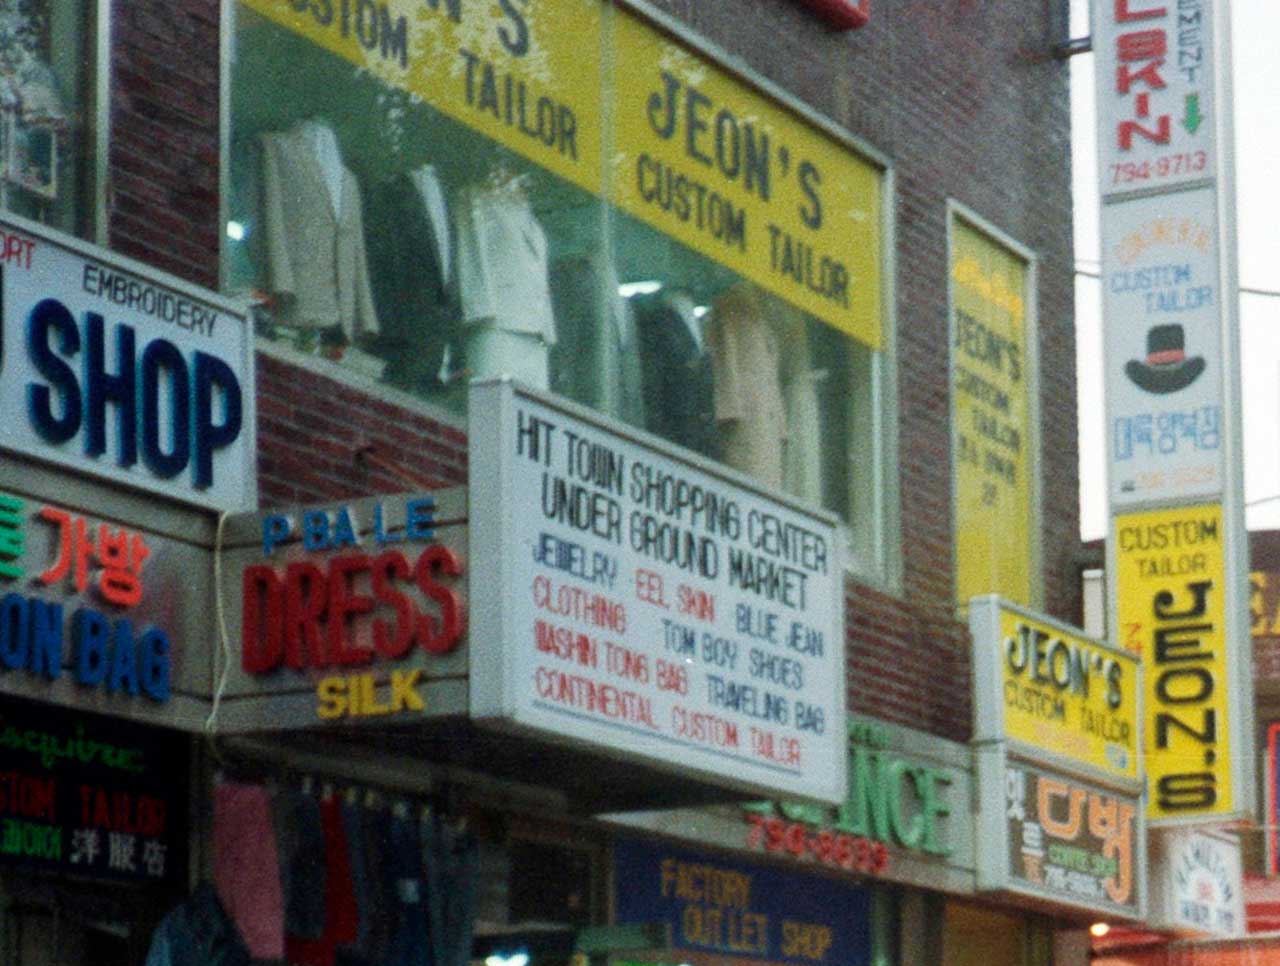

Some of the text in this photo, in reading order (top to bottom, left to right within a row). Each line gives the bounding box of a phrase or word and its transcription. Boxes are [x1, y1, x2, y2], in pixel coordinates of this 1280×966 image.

[460, 47, 578, 162] TAILOR
[647, 70, 822, 231] JEON'S
[637, 153, 747, 253] CUSTOM
[767, 222, 850, 309] TAILOR
[82, 263, 218, 337] EMBROIDERY
[25, 298, 243, 492] SHOP
[517, 409, 829, 575] HIT TOWN SHOPPING CENTER
[541, 472, 808, 611] UNDER GROUND MARKET
[1119, 519, 1218, 551] CUSTOM
[242, 545, 466, 675] DRESS
[533, 531, 825, 657] JEWELRY EEL SKIN BLUE JEAN
[1135, 554, 1206, 578] TAILOR
[73, 606, 171, 705] BAG
[532, 574, 803, 690] CLOTHING TOM BOY SHOES
[1004, 623, 1122, 710] JEON'S
[317, 667, 425, 720] SILK
[535, 665, 659, 730] CONTINENTAL
[672, 704, 739, 747] CUSTOM
[749, 726, 802, 766] TAILOR
[656, 658, 688, 695] BAG
[795, 701, 826, 736] BAG
[1004, 679, 1066, 722] CUSTOM
[1080, 704, 1130, 748] TAILOR
[1154, 580, 1217, 812] JEON'S
[80, 783, 168, 837] TAILOR
[661, 858, 752, 911] FACTORY
